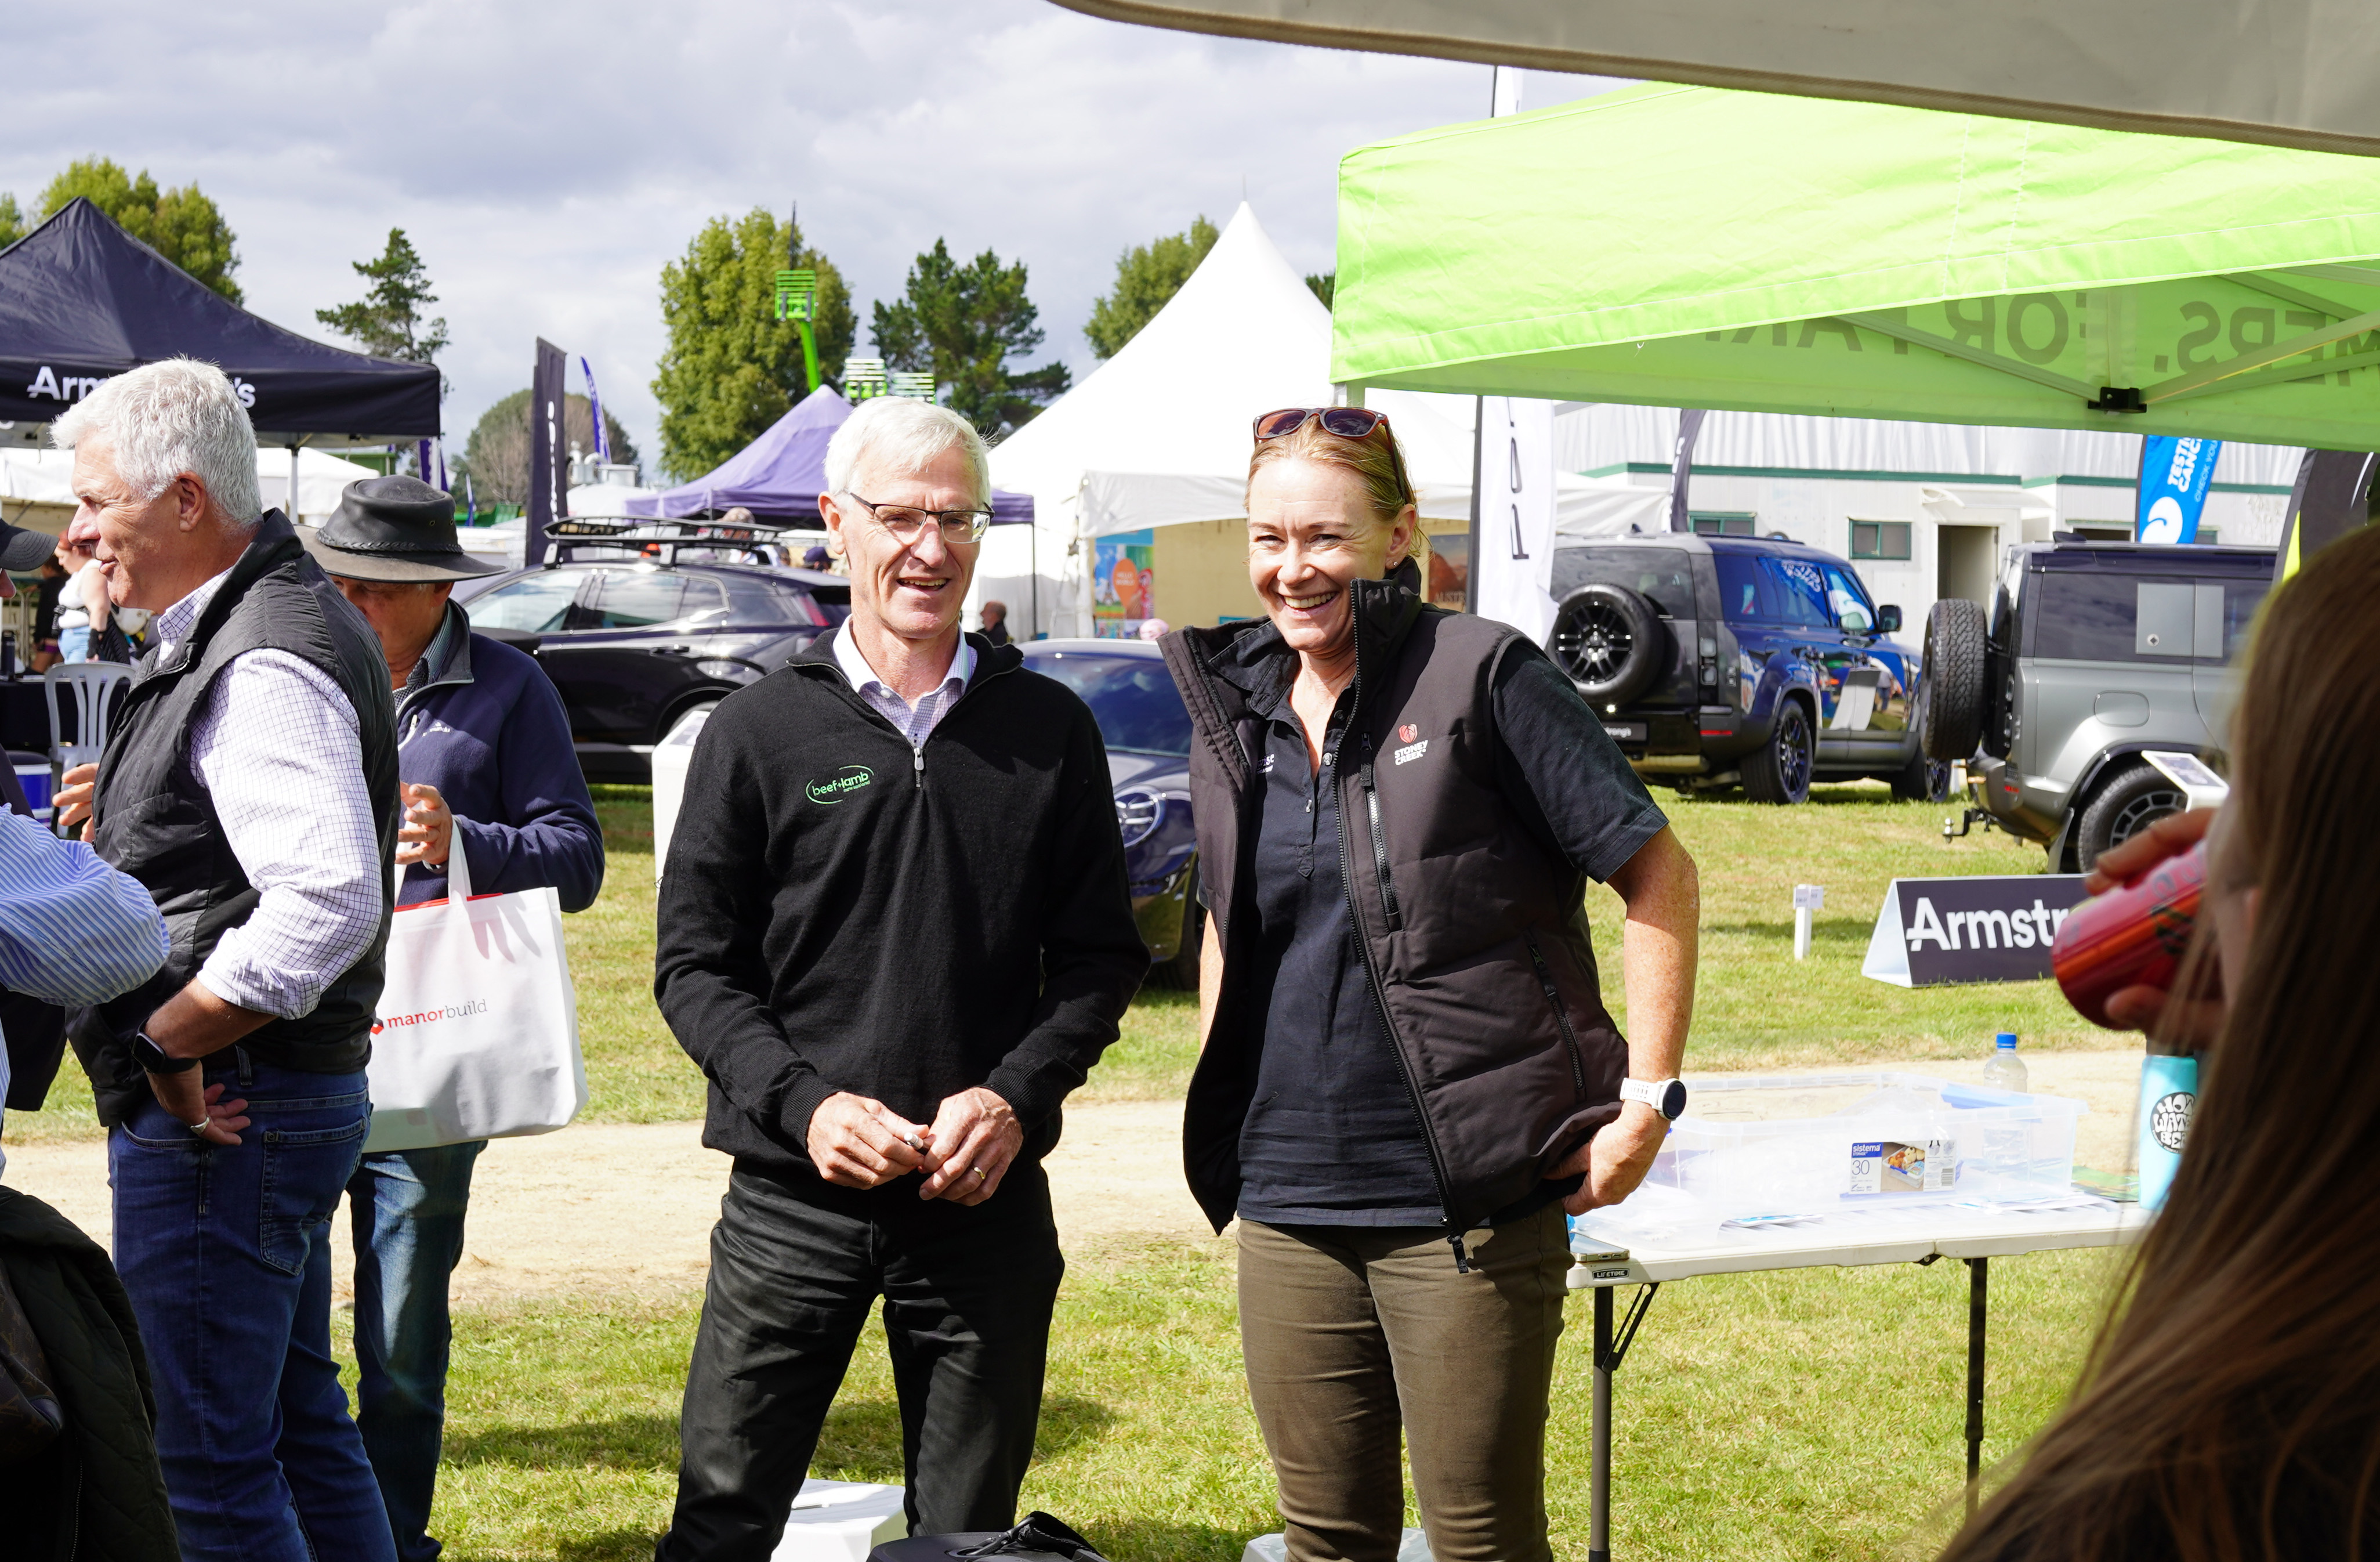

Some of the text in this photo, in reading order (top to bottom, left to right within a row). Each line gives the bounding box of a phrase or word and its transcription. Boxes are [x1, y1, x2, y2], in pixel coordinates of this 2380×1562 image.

[2167, 437, 2191, 486] TESTI
[2178, 438, 2203, 493] CANC
[1604, 726, 1632, 738] trong's
[1394, 739, 1429, 759] STONEY
[1394, 750, 1423, 766] CREEK
[1906, 897, 2069, 952] Armstr
[387, 999, 488, 1029] manorbuild
[2156, 1094, 2194, 1114] HOT
[1853, 1144, 1881, 1153] sistema
[1852, 1159, 1870, 1176] 30
